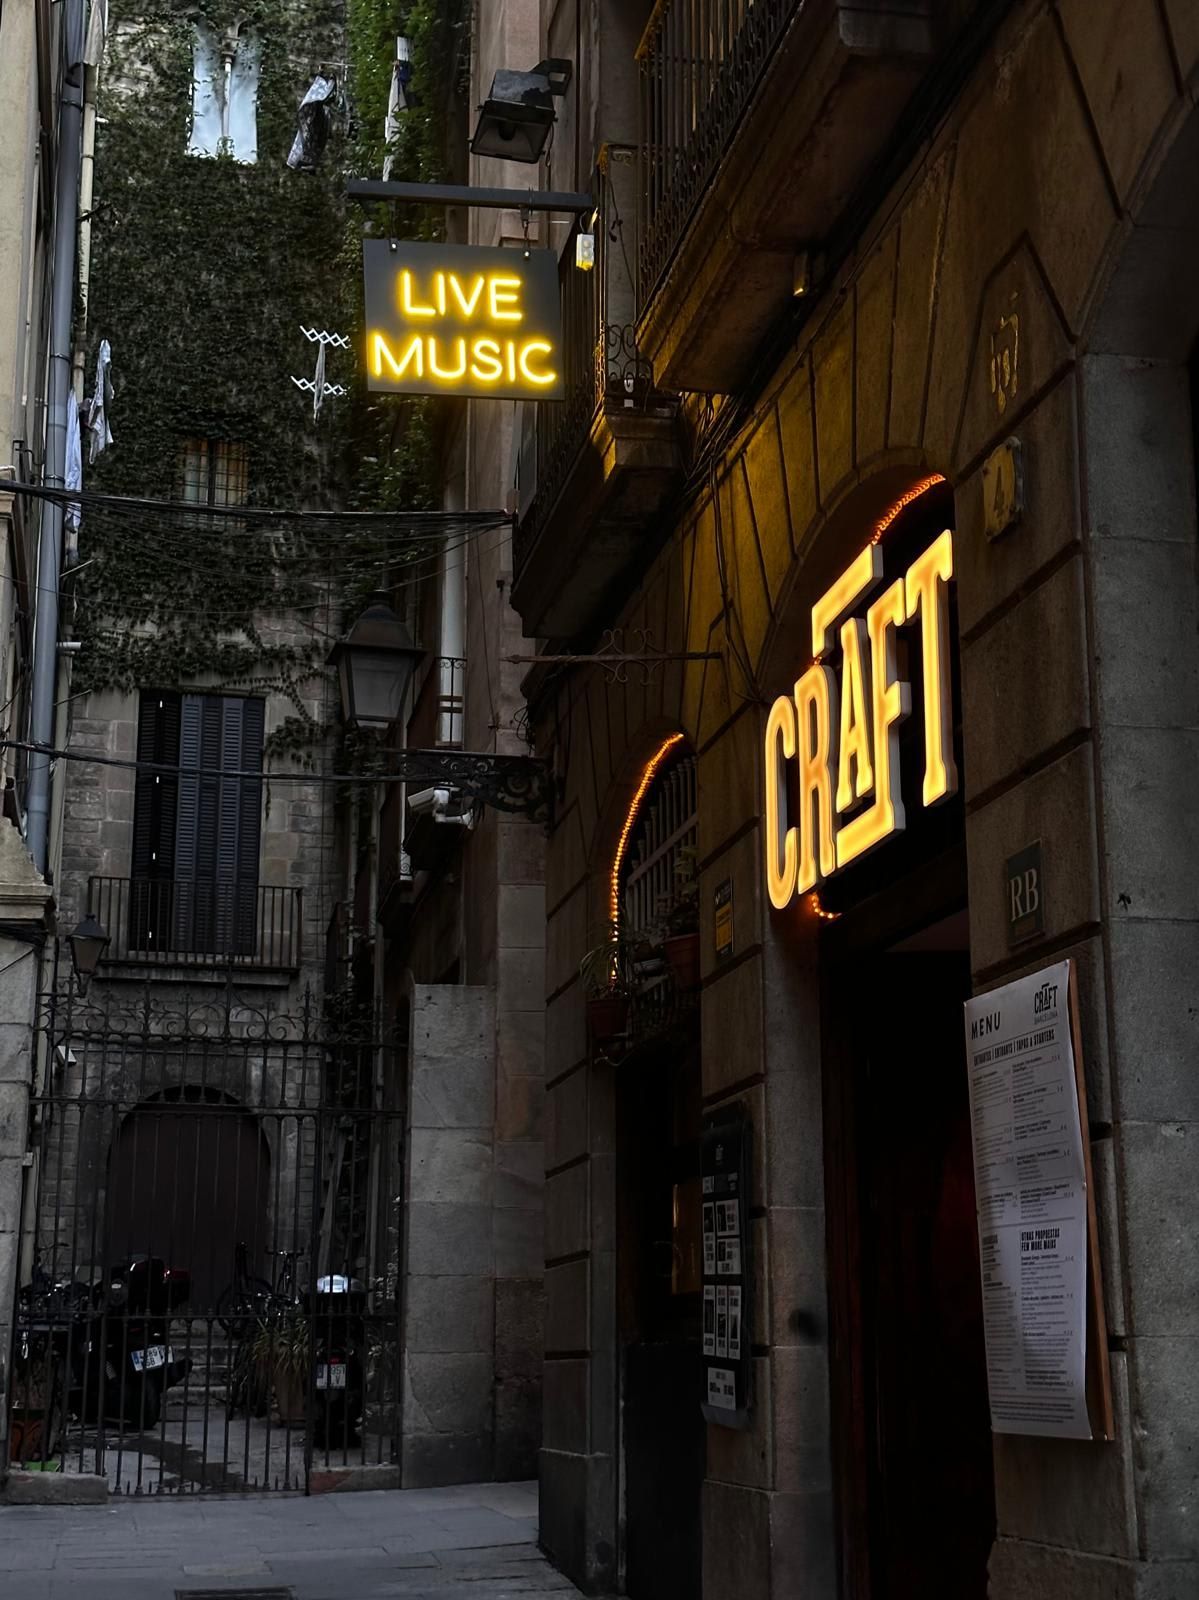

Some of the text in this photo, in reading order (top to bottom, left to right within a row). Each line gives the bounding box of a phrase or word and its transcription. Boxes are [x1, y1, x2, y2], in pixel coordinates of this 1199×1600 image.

[401, 269, 523, 321] LIVE
[370, 331, 557, 384] MUSIC
[765, 529, 953, 909] CRAFT
[1009, 866, 1039, 923] RB
[1034, 983, 1058, 1014] CRAFT
[971, 1012, 1001, 1040] MENU
